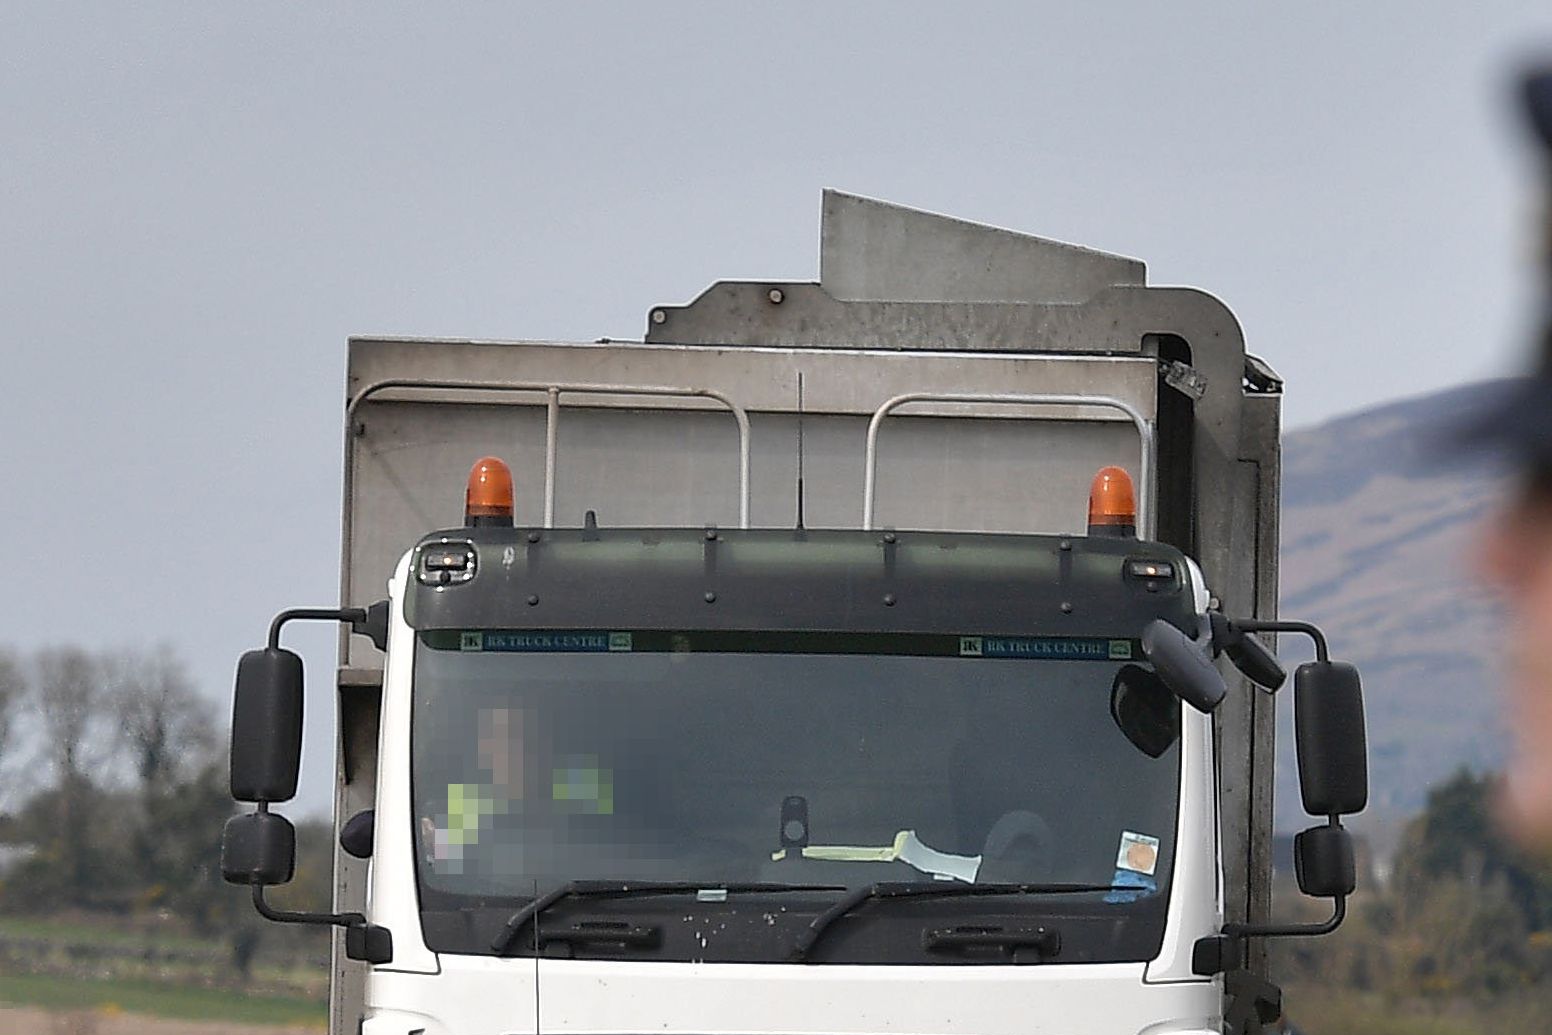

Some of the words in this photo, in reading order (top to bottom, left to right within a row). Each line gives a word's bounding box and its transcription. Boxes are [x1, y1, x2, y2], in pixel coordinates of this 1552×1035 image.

[509, 635, 551, 648] TRUCK
[554, 635, 606, 648] CENTRE
[1008, 641, 1052, 653] TRUCK
[1053, 641, 1105, 654] CENTRE
